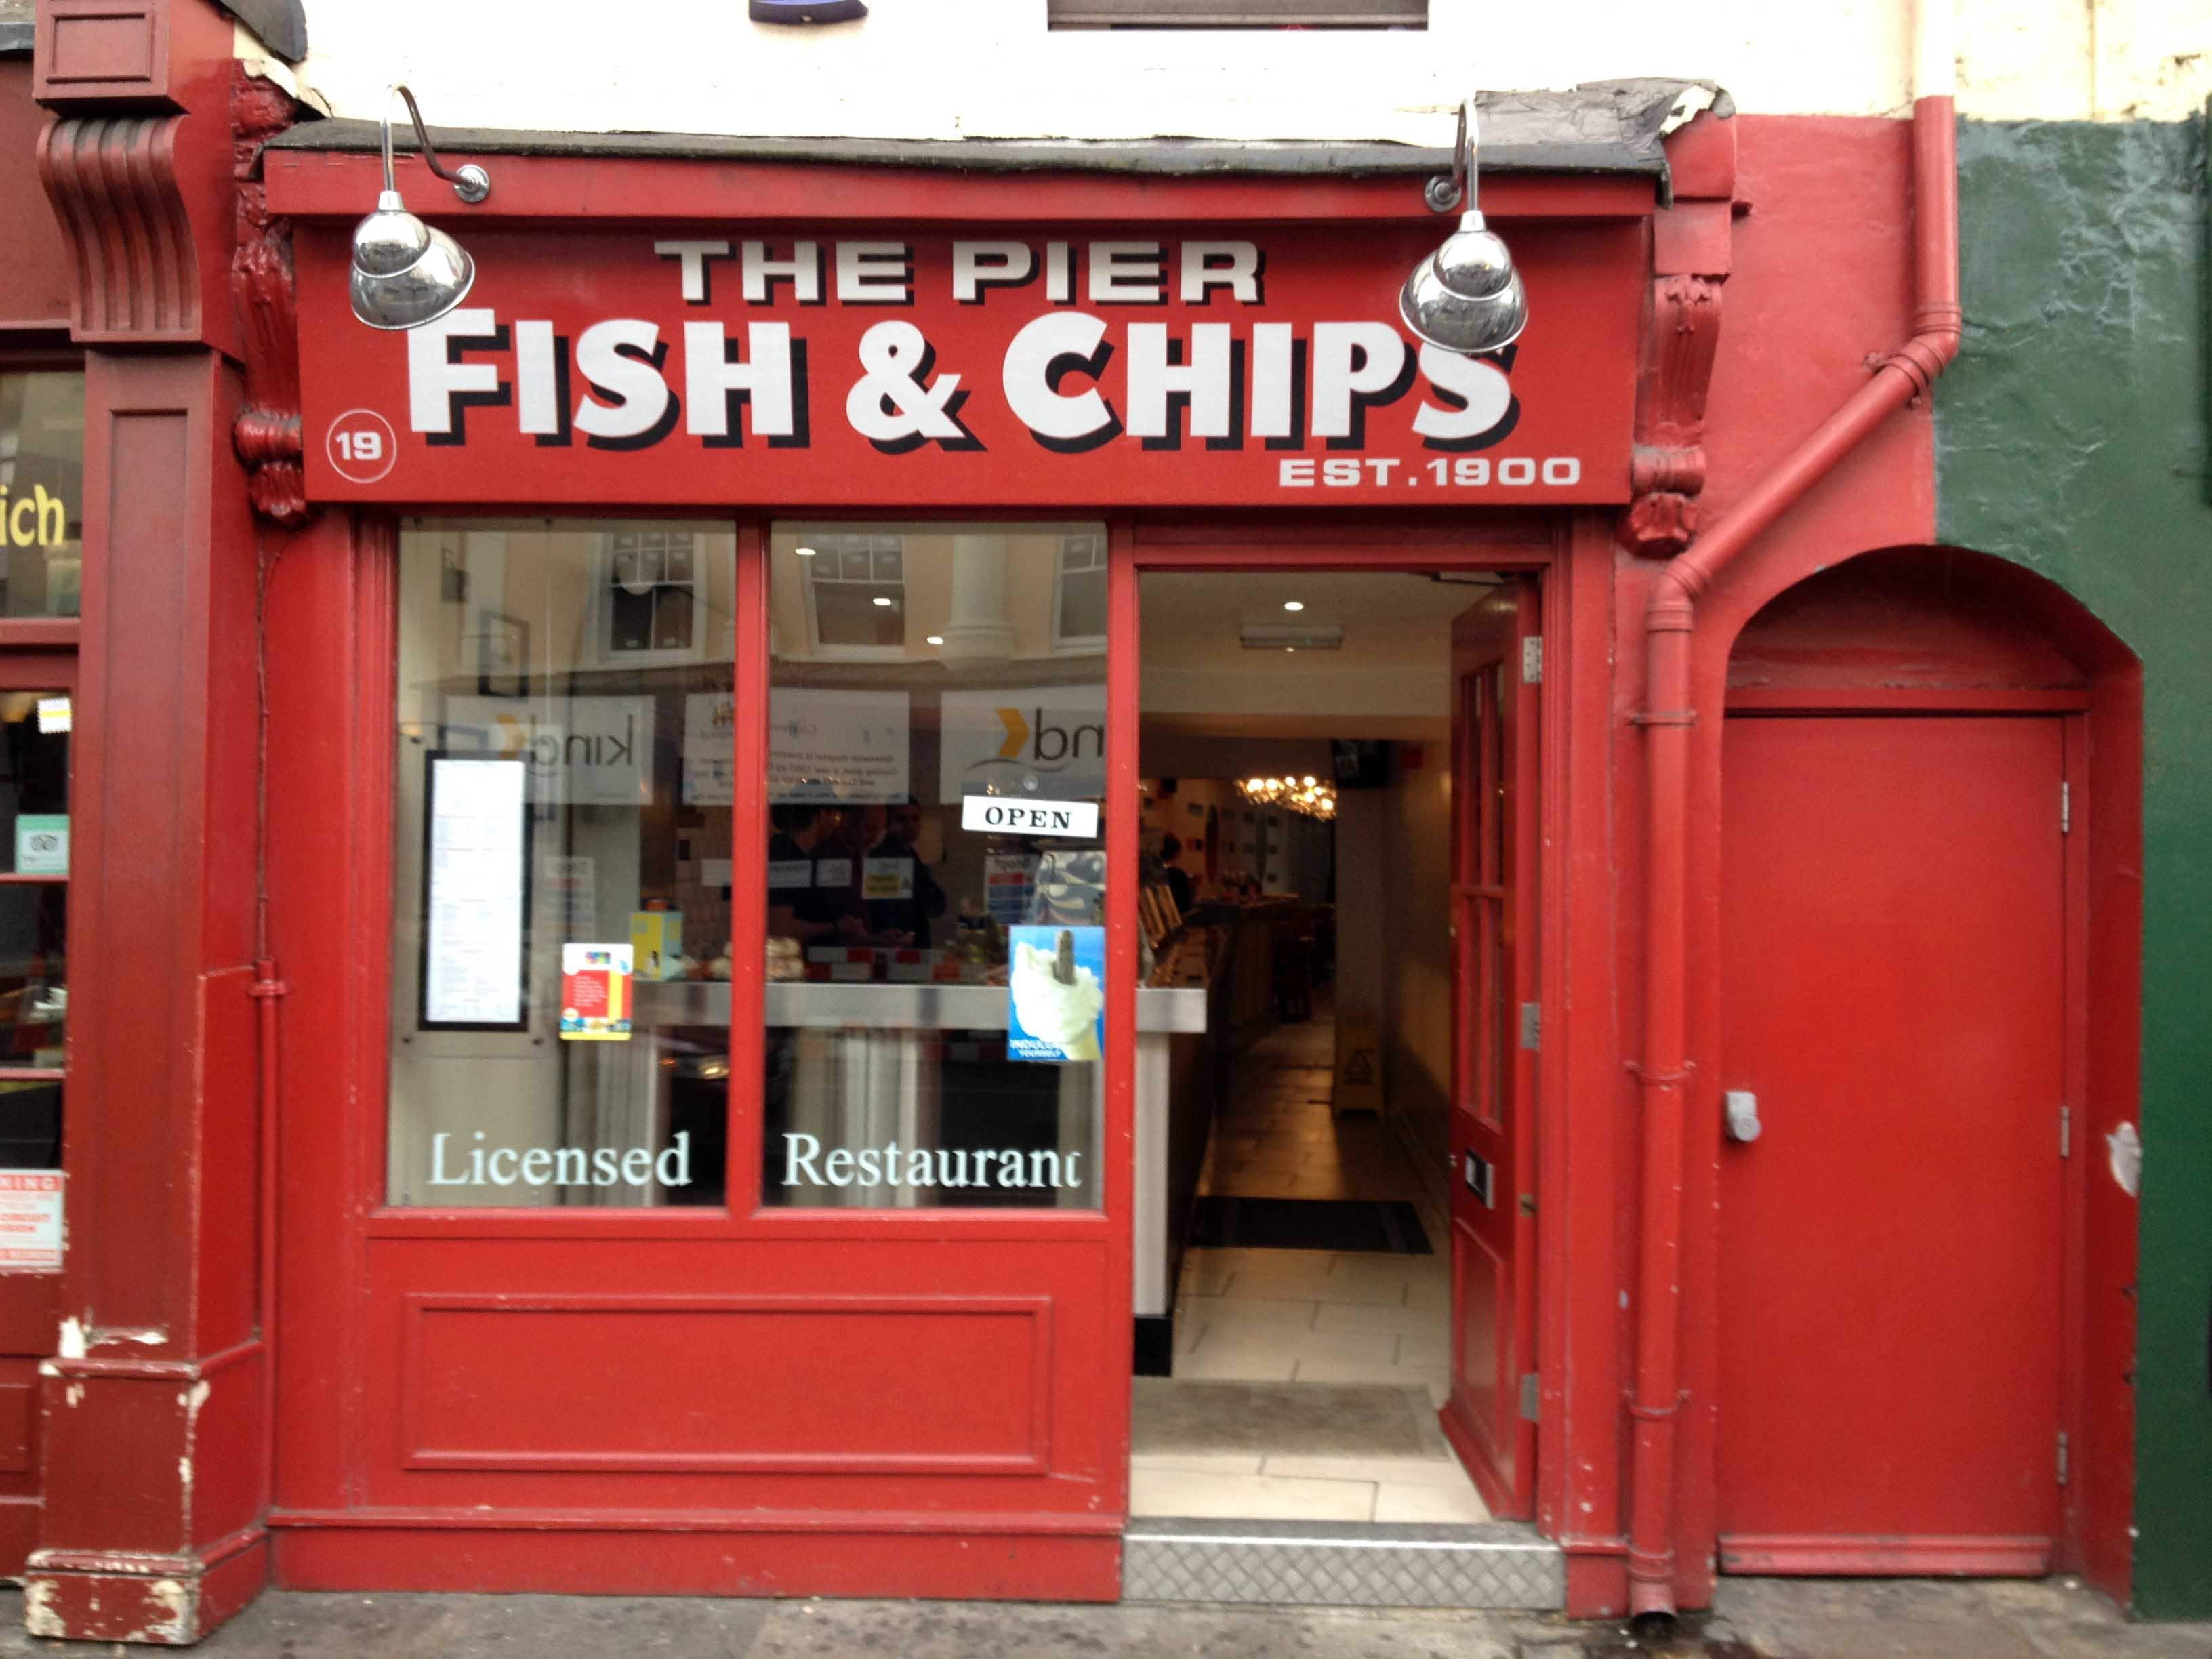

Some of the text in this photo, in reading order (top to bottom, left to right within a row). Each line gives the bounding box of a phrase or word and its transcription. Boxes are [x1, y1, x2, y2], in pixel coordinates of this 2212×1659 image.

[654, 240, 1261, 304] THE PIER
[407, 308, 1515, 445] FISH & CHIPS
[335, 431, 382, 461] 19
[985, 806, 1072, 830] OPEN
[427, 1130, 693, 1187] Licensed
